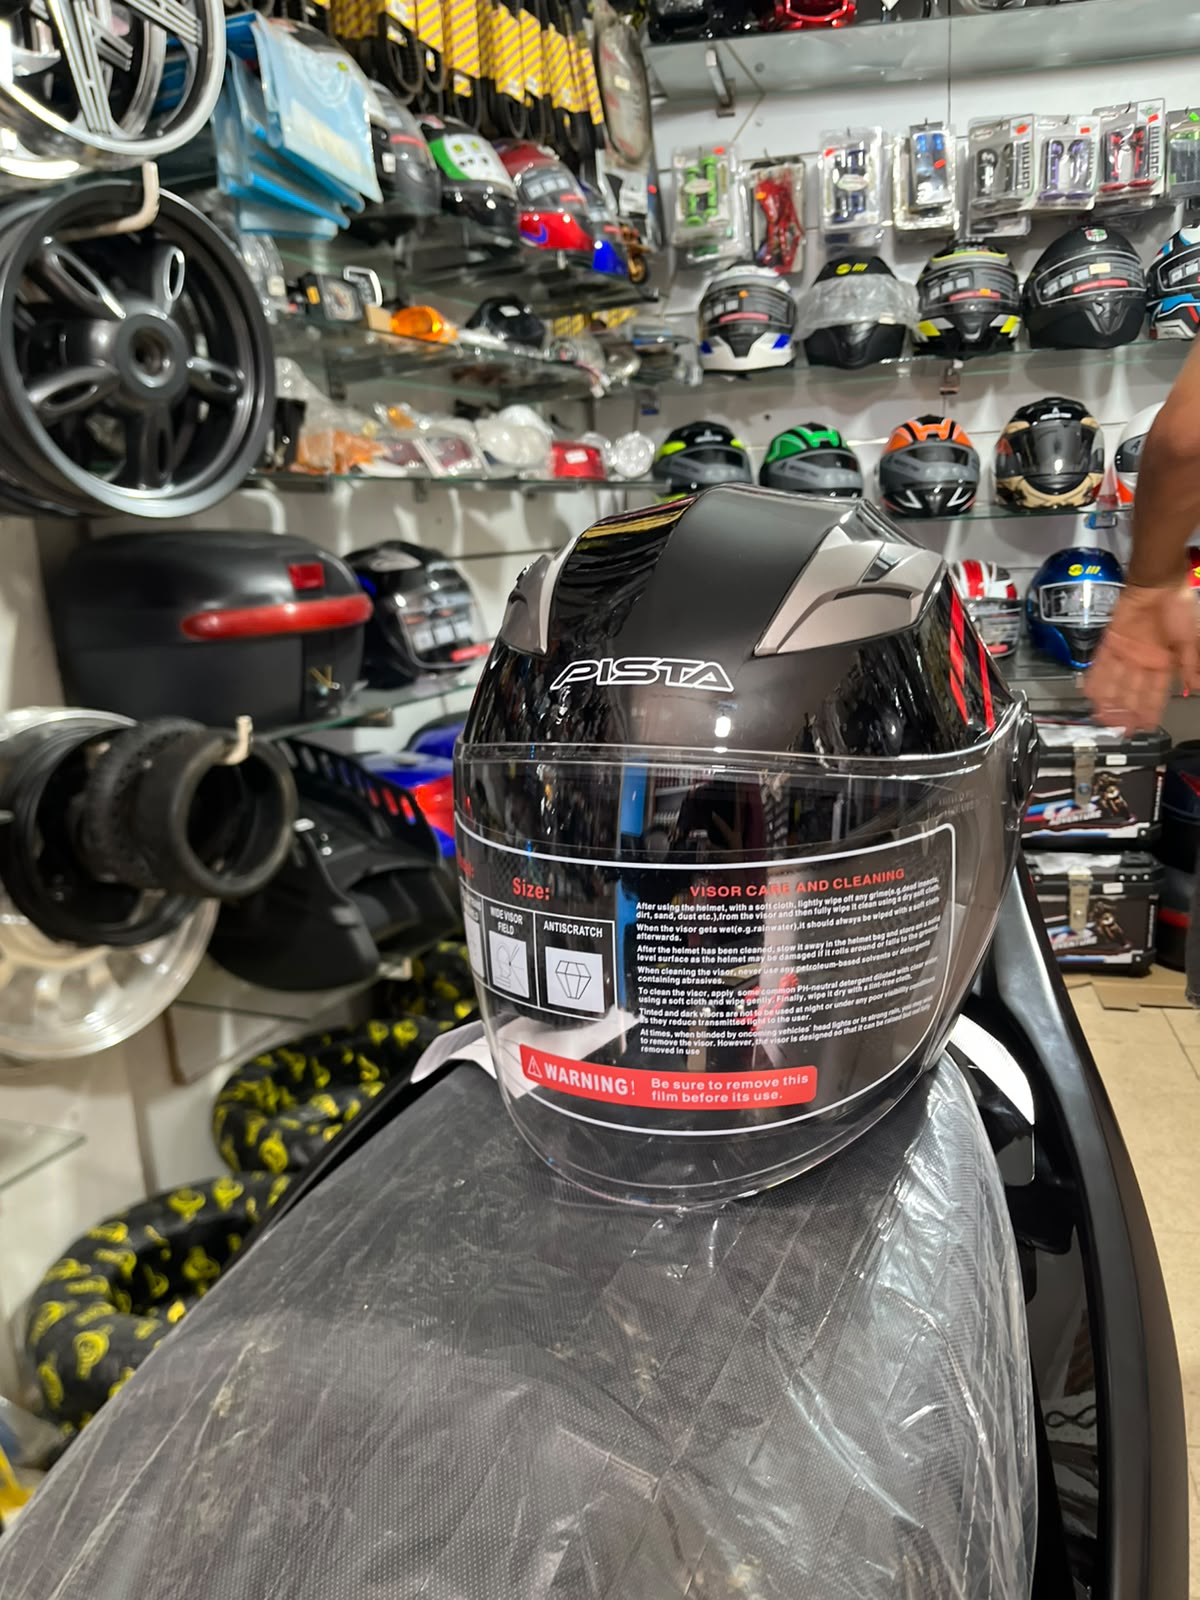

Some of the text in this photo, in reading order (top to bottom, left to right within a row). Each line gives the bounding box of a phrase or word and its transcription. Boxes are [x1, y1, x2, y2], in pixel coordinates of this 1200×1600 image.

[550, 657, 734, 692] PISTA
[512, 877, 550, 900] Size:
[690, 868, 904, 898] VISOR CARE AND CLEANING
[636, 902, 656, 910] After
[657, 903, 680, 912] using
[696, 904, 728, 912] helmet,
[798, 898, 823, 908] lightly
[824, 896, 842, 906] wipe
[855, 894, 868, 902] any
[490, 906, 504, 920] WIDE
[504, 910, 524, 925] VISOR
[636, 912, 652, 920] dirt,
[654, 913, 676, 921] sand,
[755, 912, 776, 920] visor
[778, 910, 794, 918] and
[814, 907, 831, 916] fully
[833, 904, 850, 913] wipe
[636, 923, 659, 932] When
[698, 926, 717, 934] gets
[807, 918, 834, 928] should
[836, 916, 861, 926] always
[873, 909, 893, 920] wiped
[498, 922, 514, 936] FIELD
[544, 920, 603, 938] ANTISCRATCH
[636, 933, 682, 942] afterwards.
[637, 944, 656, 953] After
[672, 946, 700, 954] helmet
[805, 942, 824, 950] away
[834, 938, 846, 946] the
[848, 934, 872, 944] helmet
[637, 954, 656, 962] level
[658, 955, 690, 963] surface
[717, 956, 746, 964] helmet
[748, 956, 766, 964] may
[779, 952, 816, 961] damaged
[850, 944, 876, 952] around
[638, 966, 660, 974] When
[661, 968, 696, 978] cleaning
[712, 968, 737, 977] visor,
[638, 976, 725, 986] containing abrasives.
[638, 986, 648, 994] To
[686, 989, 710, 998] visor,
[711, 990, 734, 998] apply
[638, 996, 660, 1006] using
[808, 992, 826, 1000] wipe
[639, 1008, 663, 1016] Tinted
[680, 1010, 698, 1018] dark
[775, 1007, 794, 1015] used
[804, 1004, 824, 1014] night
[650, 1018, 668, 1026] they
[640, 1028, 648, 1036] At
[650, 1029, 673, 1038] times,
[696, 1030, 725, 1038] blinded
[727, 1030, 736, 1039] by
[650, 1038, 678, 1046] remove
[640, 1046, 674, 1054] removed
[651, 1074, 810, 1090] Be sure to remove this
[651, 1090, 783, 1102] film before its use.
